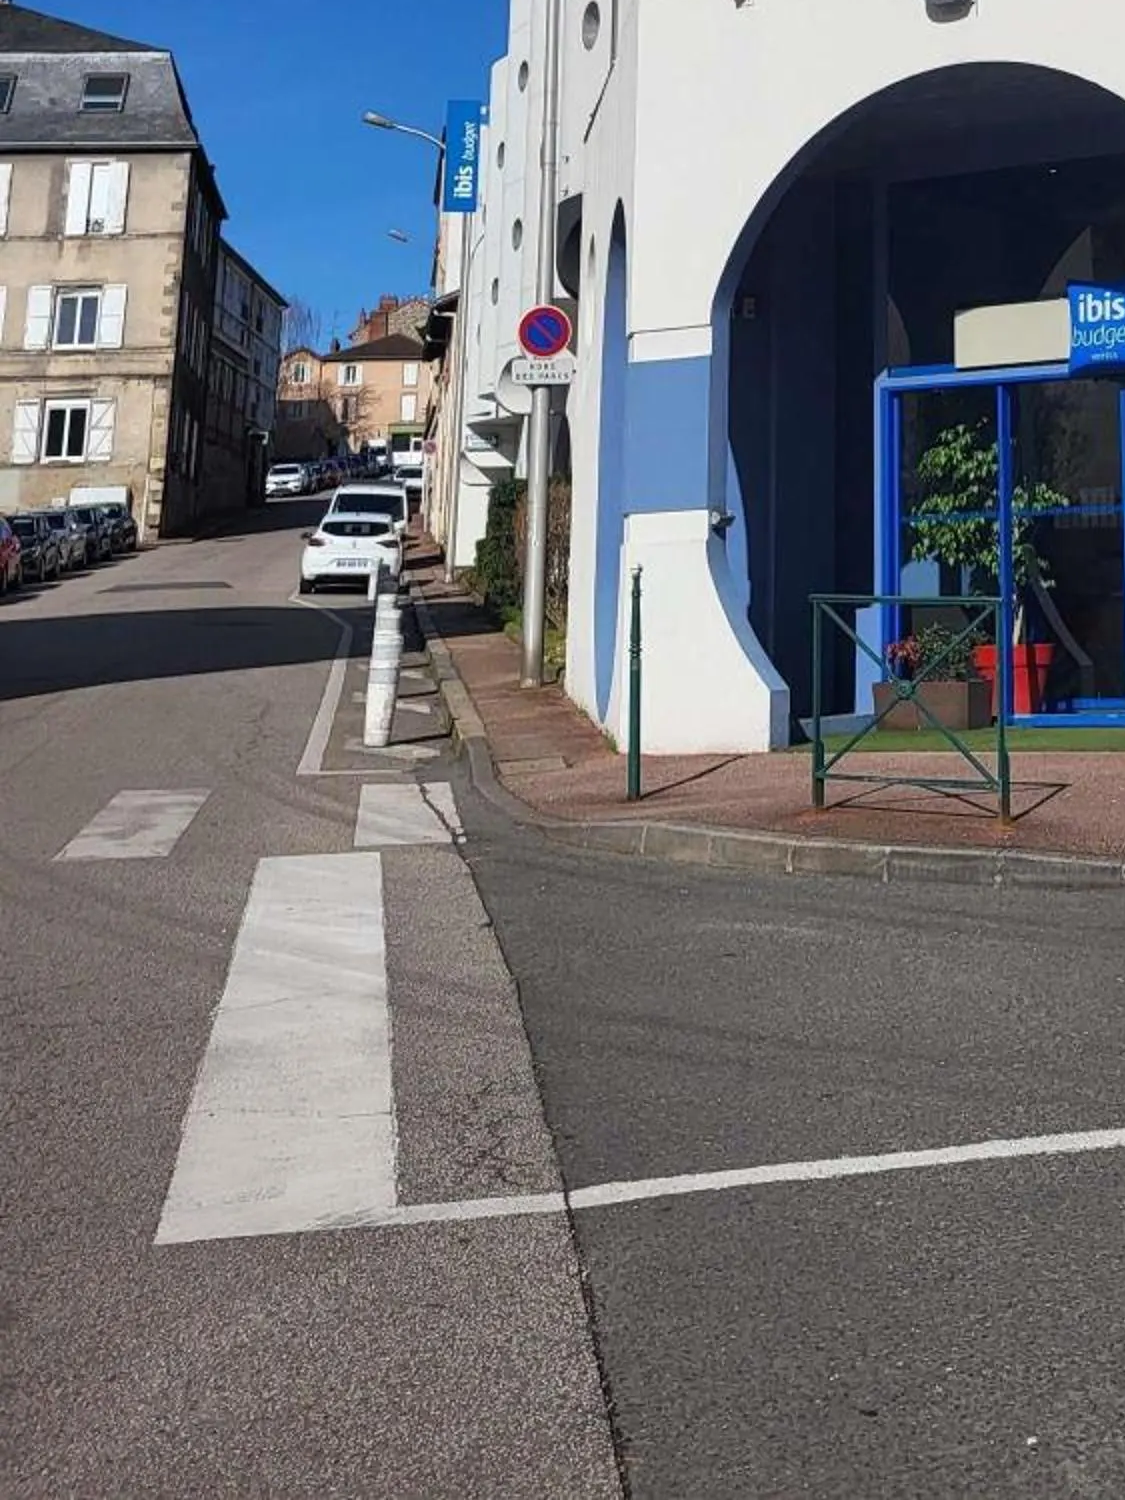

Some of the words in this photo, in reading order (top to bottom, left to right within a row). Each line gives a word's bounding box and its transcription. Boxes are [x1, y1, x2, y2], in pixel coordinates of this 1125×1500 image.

[462, 120, 478, 161] budget
[453, 165, 473, 198] ibis
[1078, 291, 1125, 323] ibis
